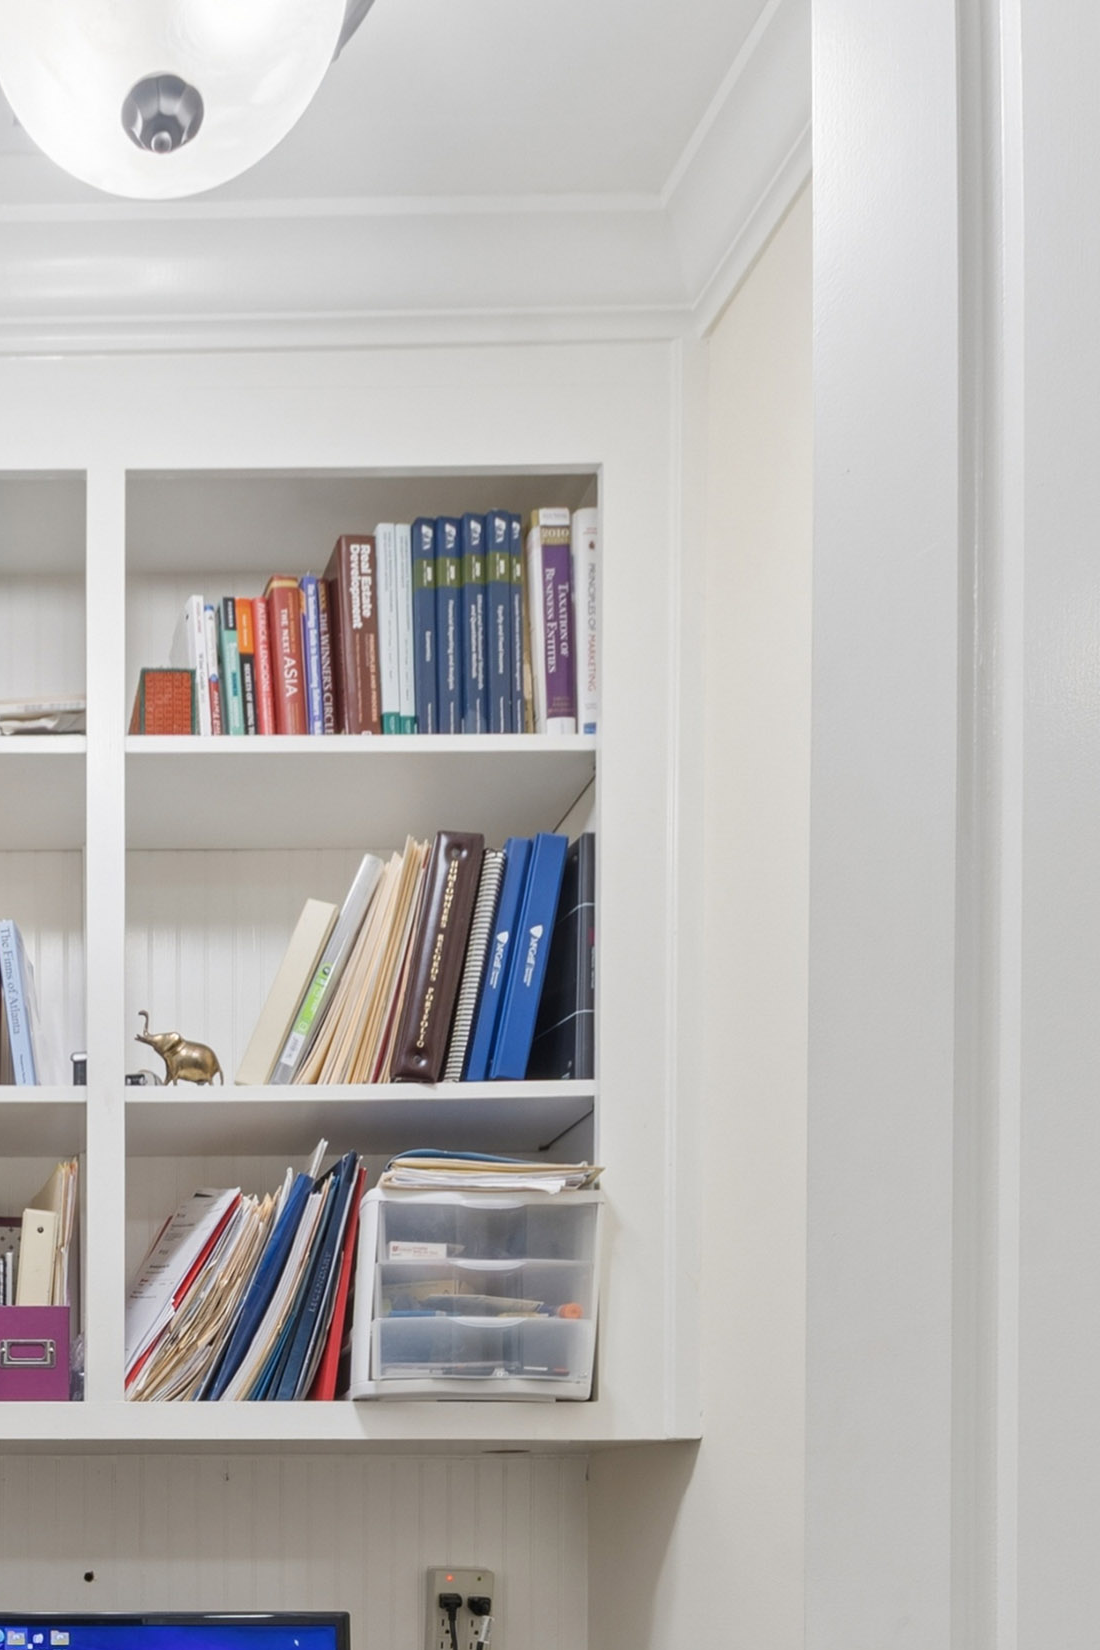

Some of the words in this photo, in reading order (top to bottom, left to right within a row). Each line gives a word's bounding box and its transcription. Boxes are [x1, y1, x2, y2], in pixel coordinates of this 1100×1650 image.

[361, 544, 371, 574] Real
[349, 544, 363, 630] Development
[361, 576, 372, 618] Estate
[280, 608, 288, 627] THE
[281, 629, 290, 653] NEXT
[284, 655, 298, 698] ASIA
[587, 634, 597, 692] MARKETING
[0, 928, 11, 948] The
[3, 951, 15, 981] Finns
[9, 996, 21, 1035] Atlanta
